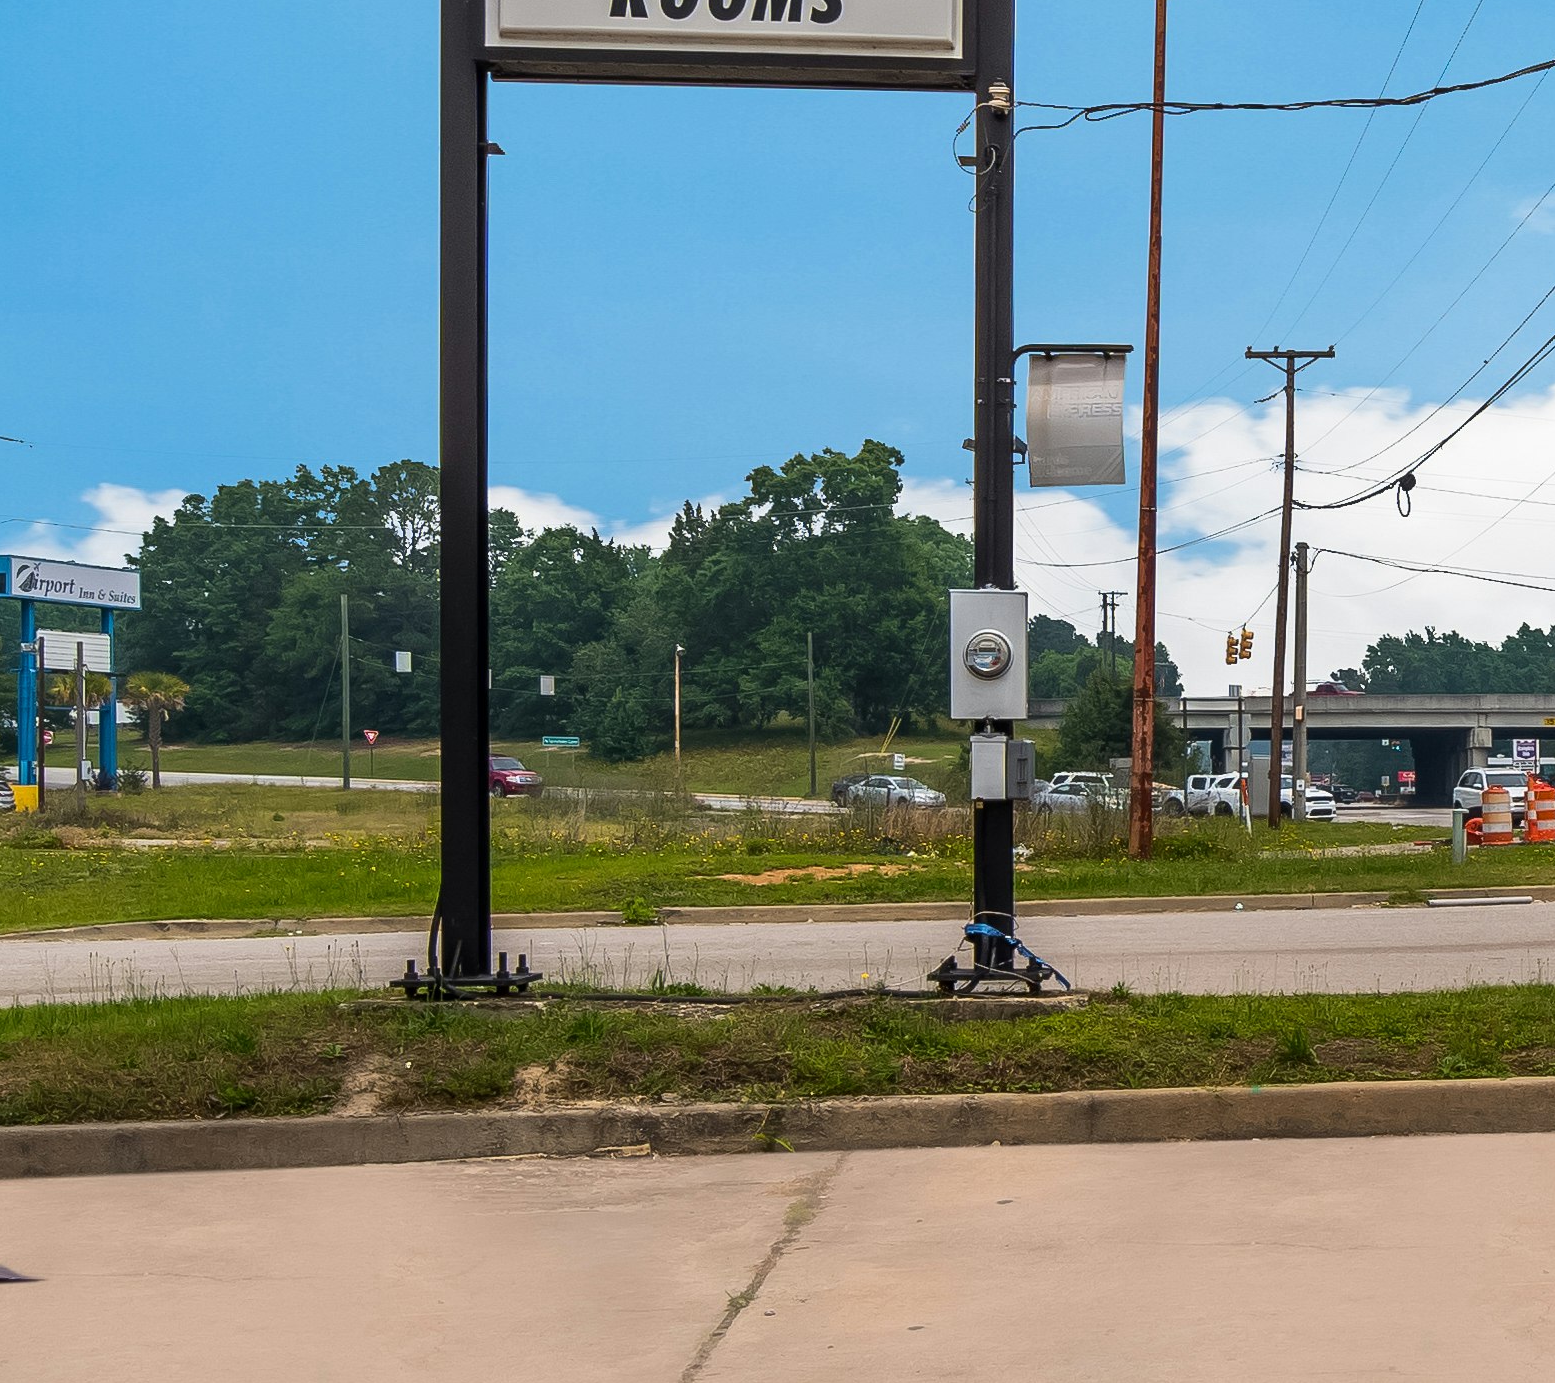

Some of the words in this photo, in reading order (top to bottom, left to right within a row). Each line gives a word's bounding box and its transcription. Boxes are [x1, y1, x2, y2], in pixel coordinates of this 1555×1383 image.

[16, 564, 76, 597] Airport
[78, 587, 95, 600] Inn
[97, 588, 106, 600] &
[108, 588, 136, 604] Suites
